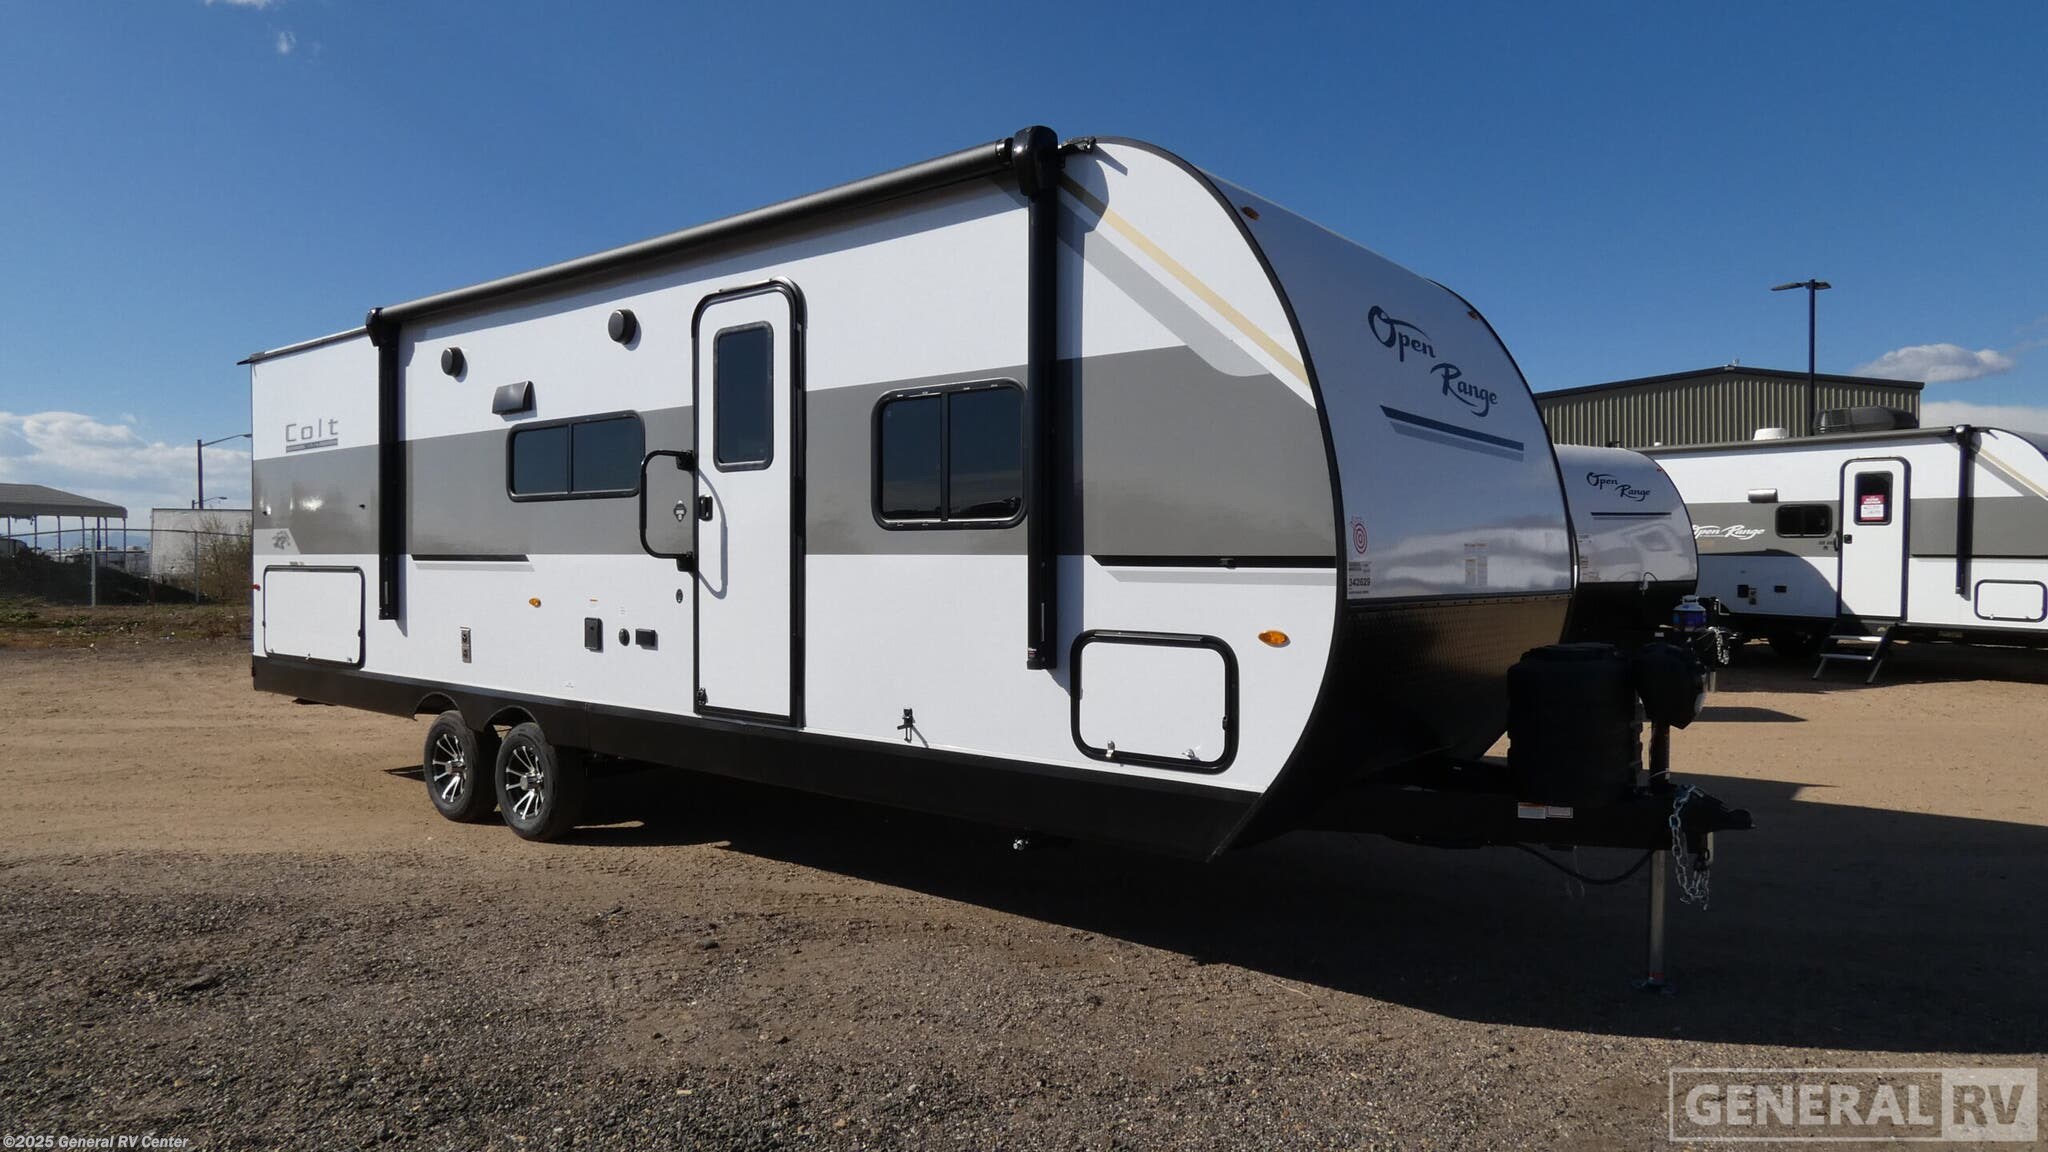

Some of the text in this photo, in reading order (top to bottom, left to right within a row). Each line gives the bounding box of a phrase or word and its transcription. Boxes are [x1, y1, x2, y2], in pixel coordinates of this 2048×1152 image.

[1368, 305, 1436, 362] Open
[1430, 362, 1498, 418] Range
[285, 418, 339, 442] Colt
[1586, 472, 1618, 490] Open
[1614, 484, 1651, 502] Range
[1720, 524, 1766, 540] Range
